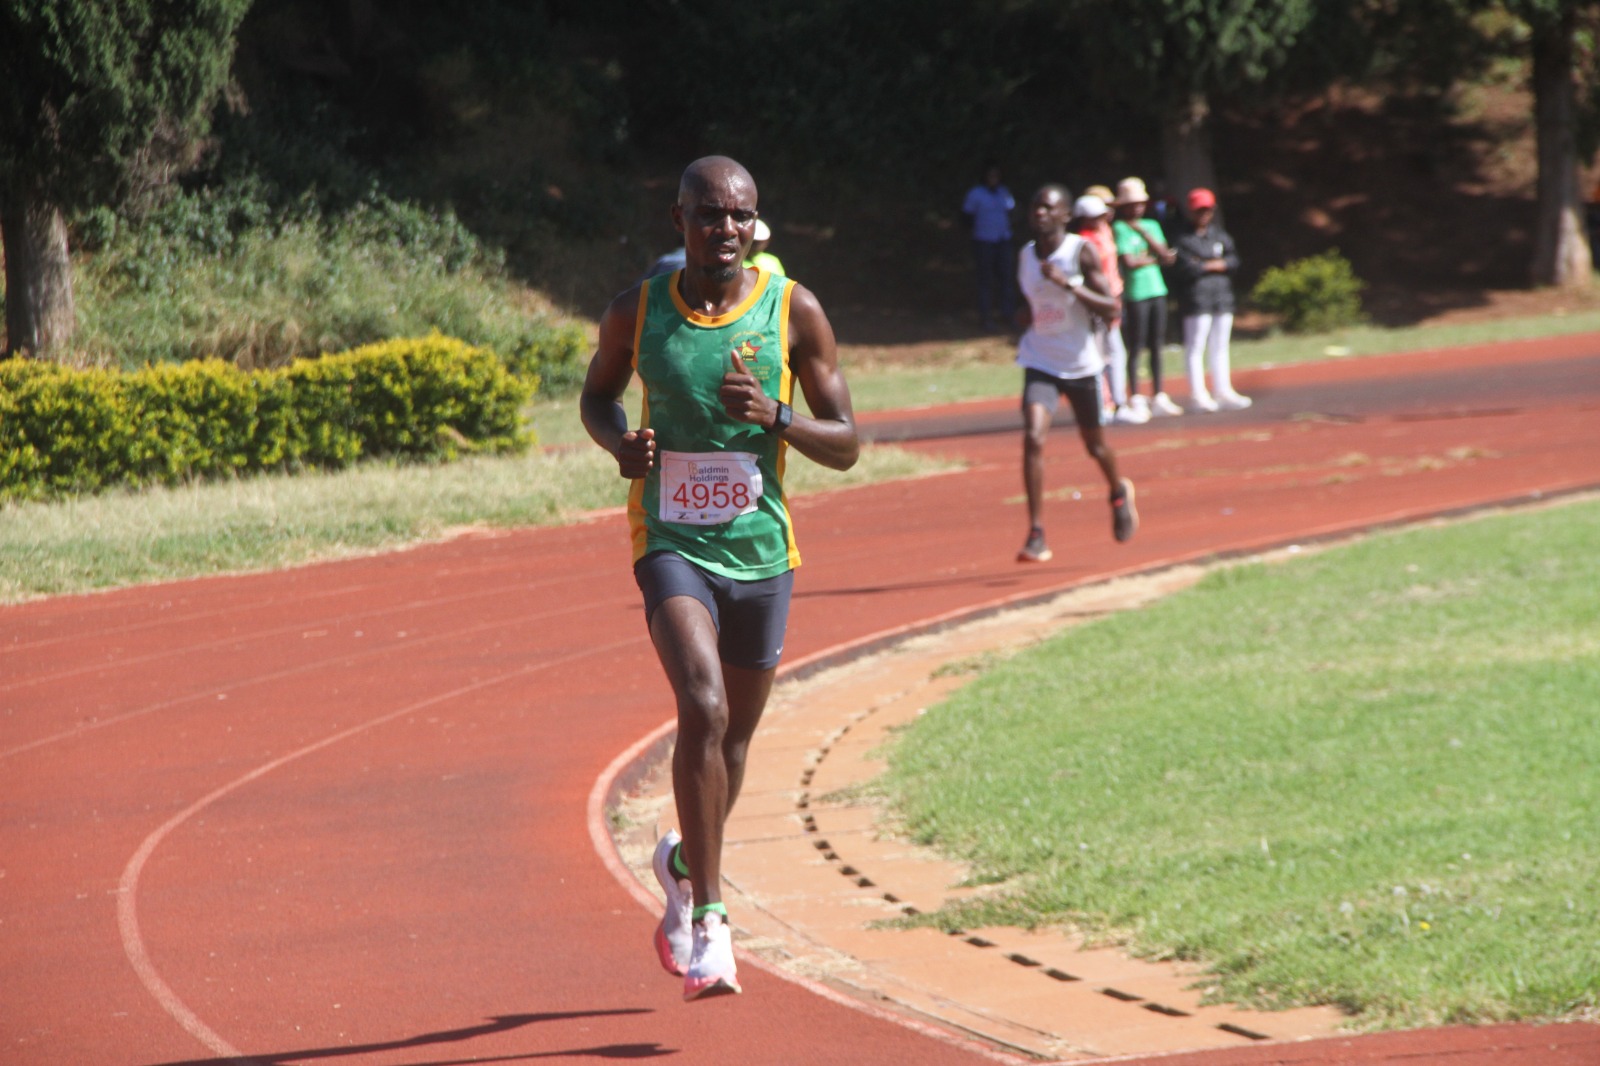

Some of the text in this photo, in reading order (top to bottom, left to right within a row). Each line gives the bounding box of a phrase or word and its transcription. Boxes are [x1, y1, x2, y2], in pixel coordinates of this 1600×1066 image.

[688, 462, 729, 474] Baldmin
[689, 474, 729, 482] Holdings
[673, 482, 749, 509] 4958
